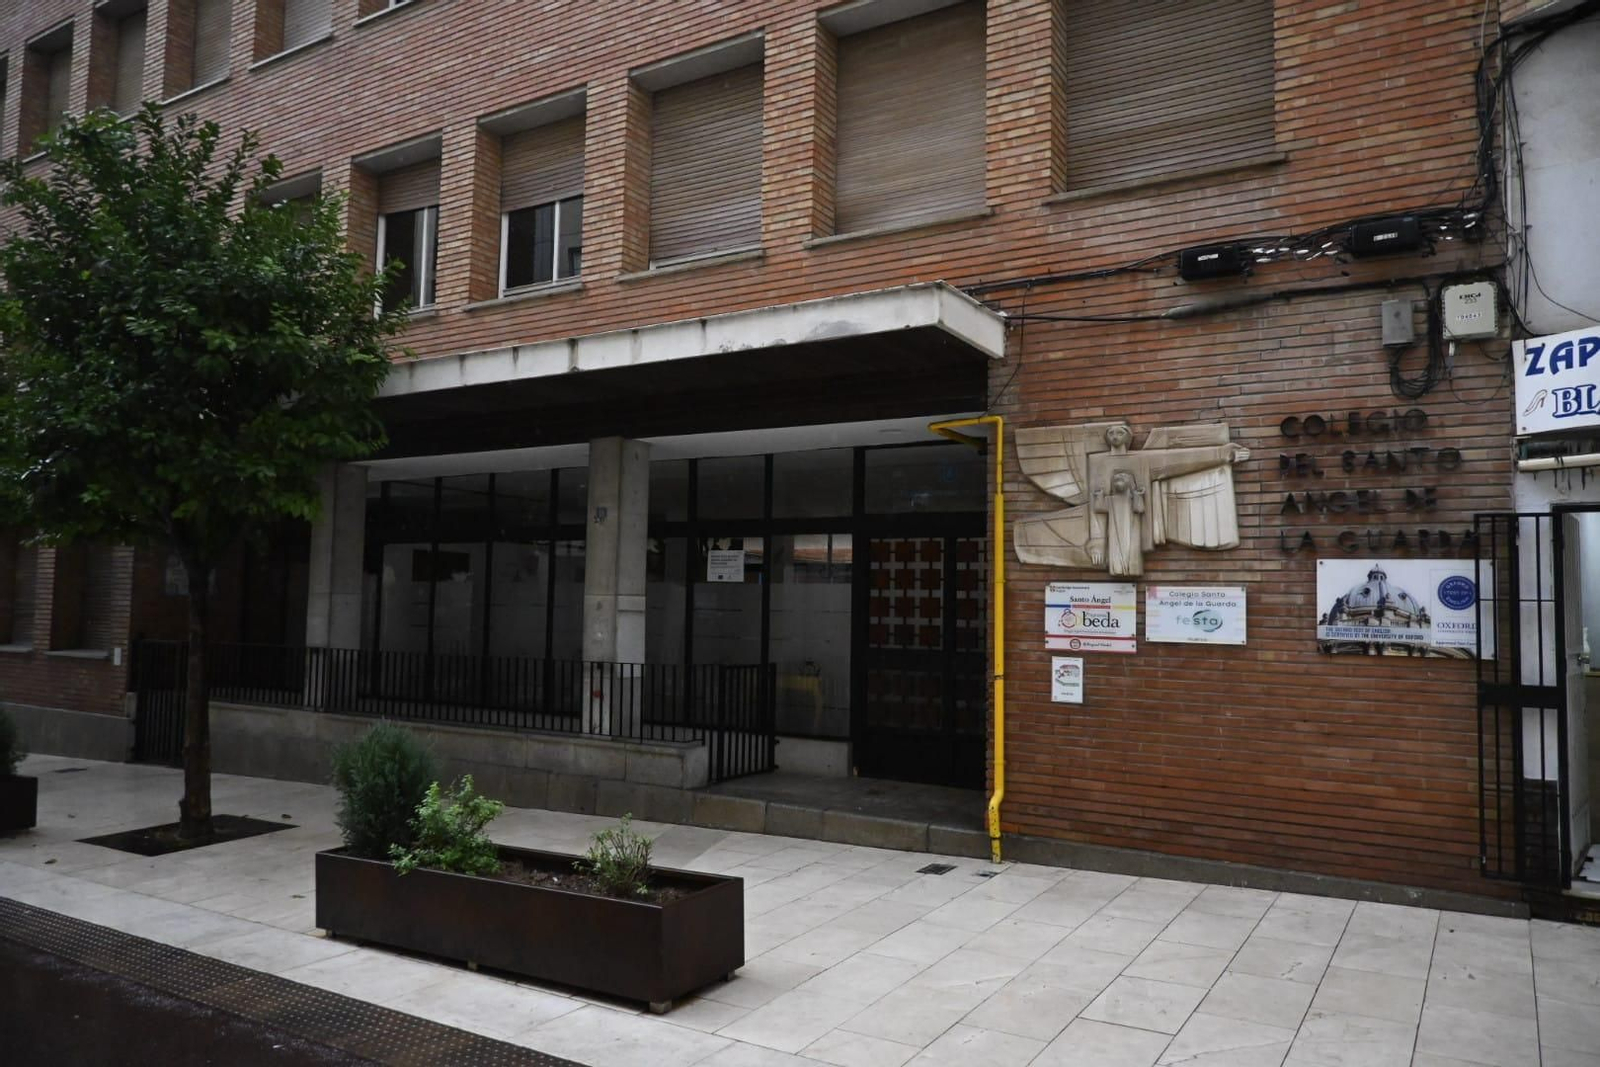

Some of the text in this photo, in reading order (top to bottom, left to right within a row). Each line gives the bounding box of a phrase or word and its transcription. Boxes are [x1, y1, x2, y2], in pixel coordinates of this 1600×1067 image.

[1525, 336, 1600, 376] ZAP
[1552, 384, 1600, 418] BL
[1280, 408, 1427, 438] COLEGIO
[1280, 447, 1461, 477] DEL SANTO
[1280, 529, 1316, 553] LA
[1091, 594, 1111, 604] Ángel
[1082, 611, 1120, 628] beda
[1176, 615, 1218, 626] festa
